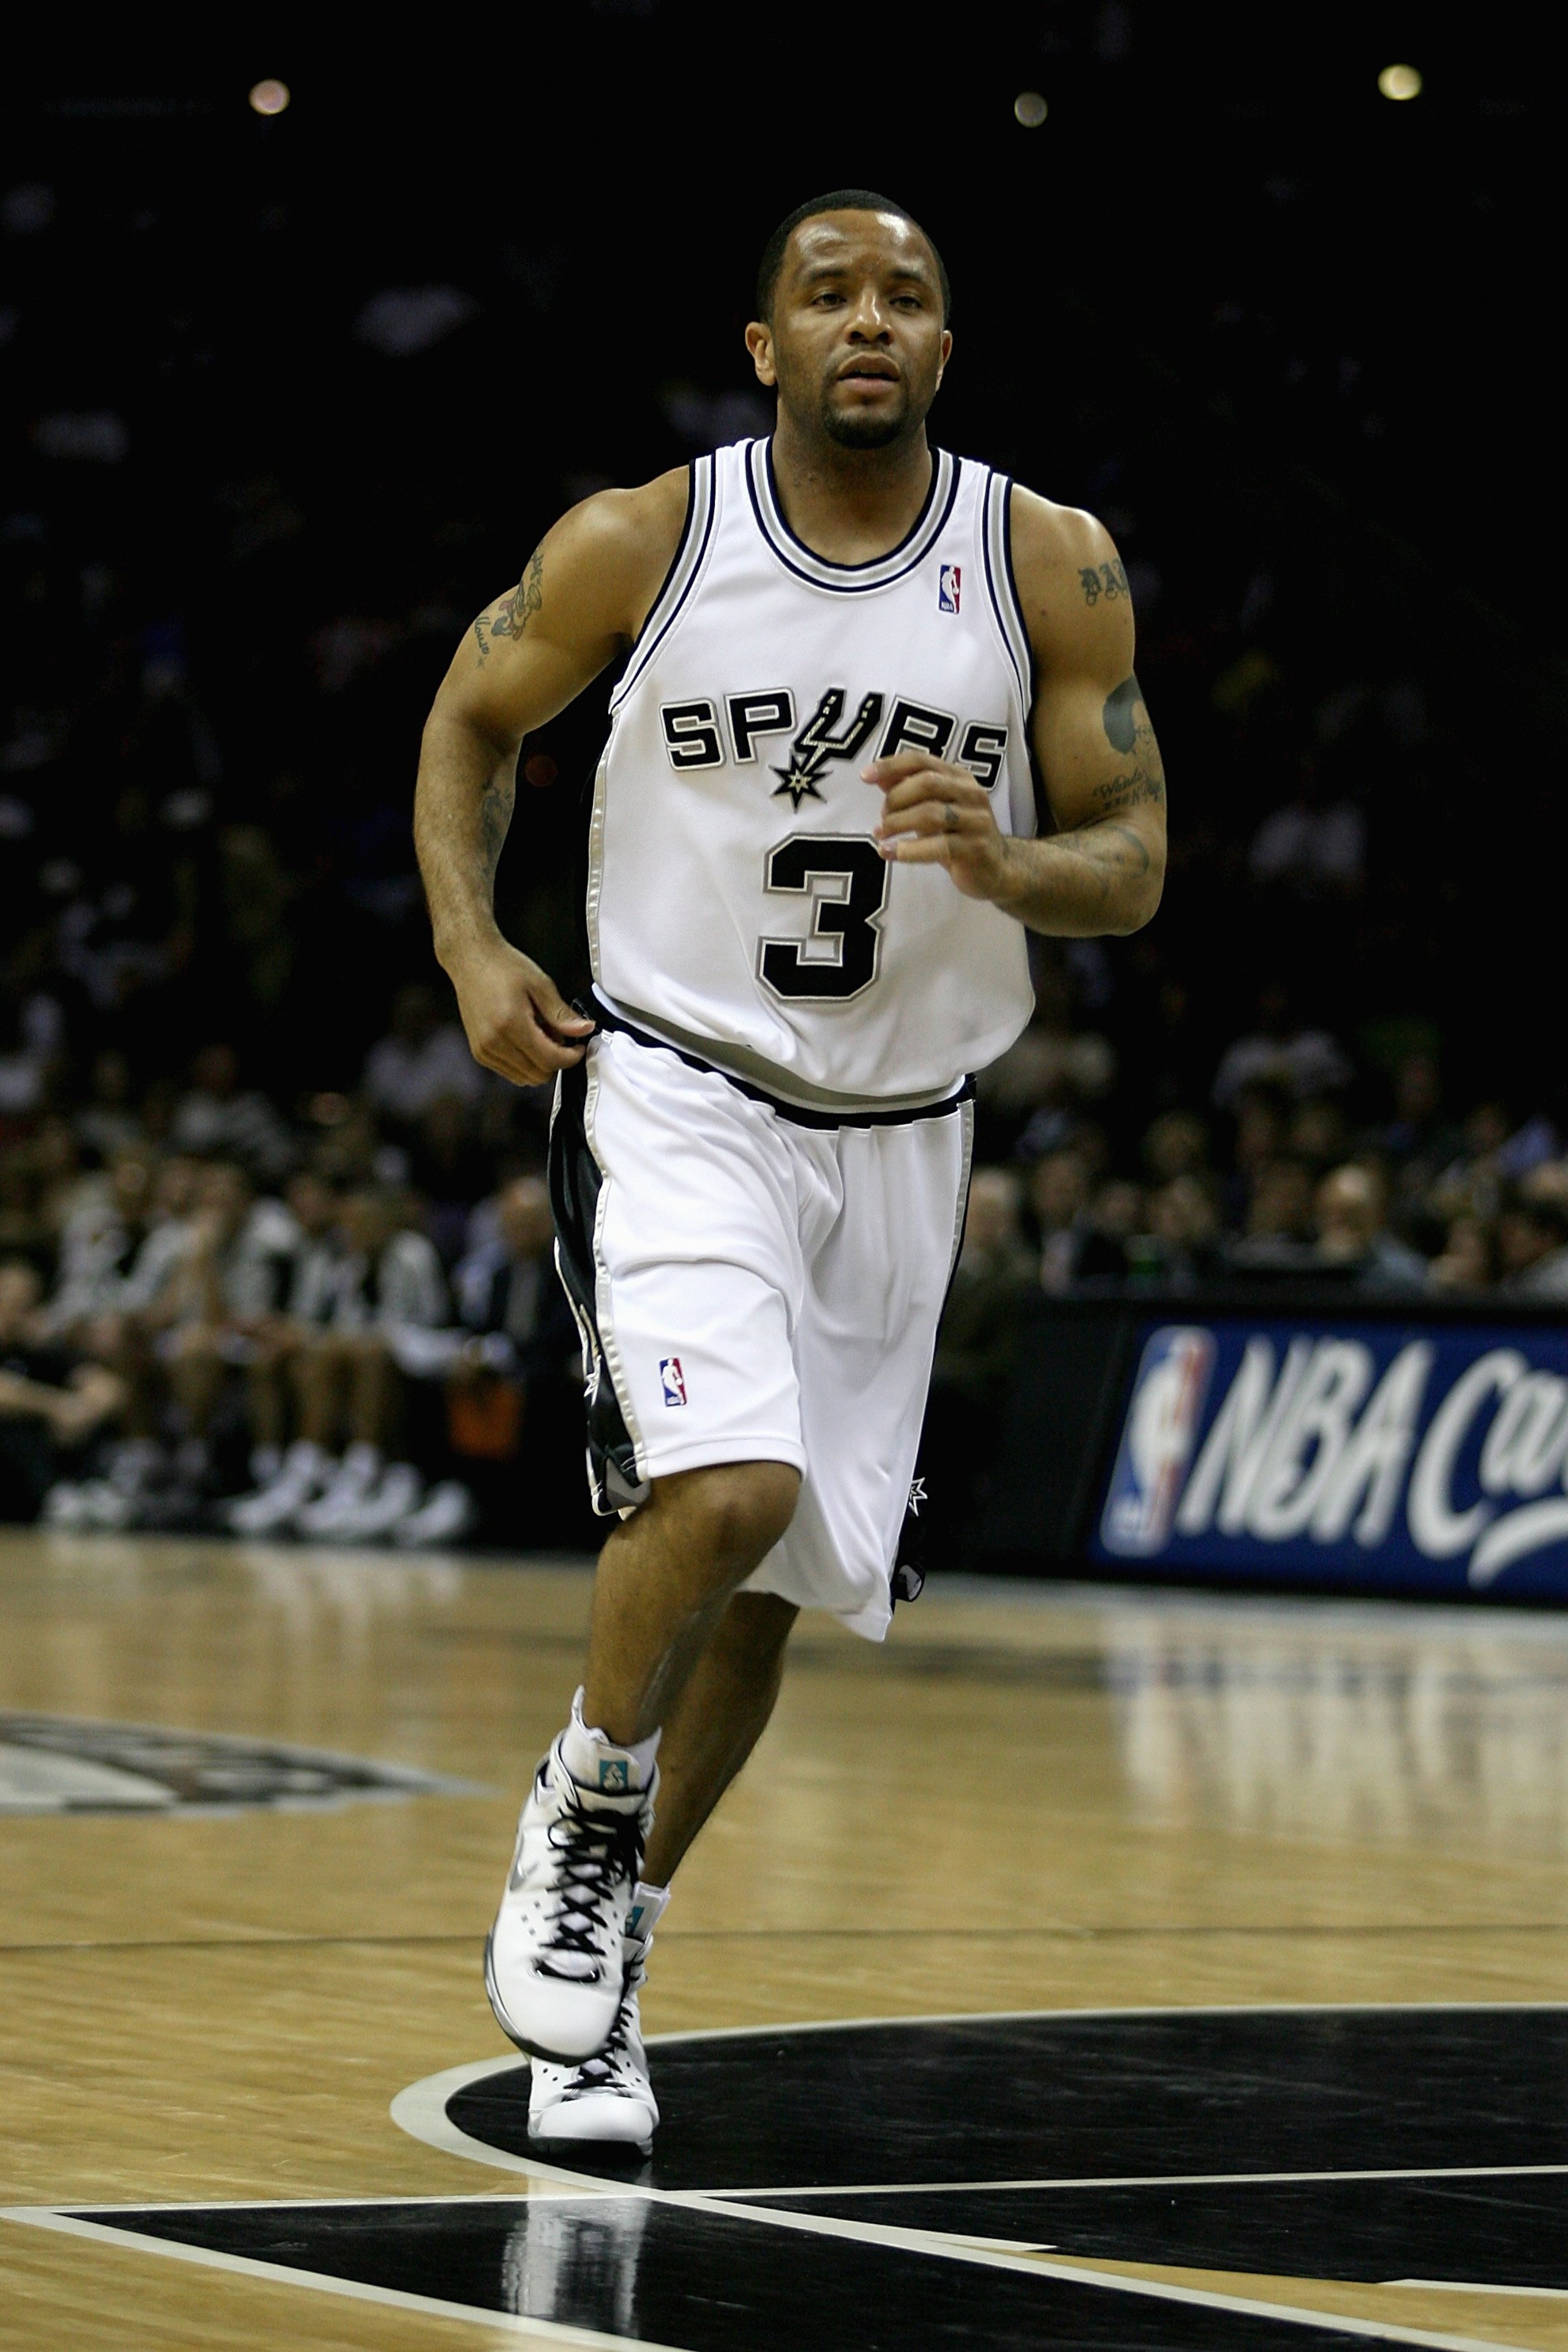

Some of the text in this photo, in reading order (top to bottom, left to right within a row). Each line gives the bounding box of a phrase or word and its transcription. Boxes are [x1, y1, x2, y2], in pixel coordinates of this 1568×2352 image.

[660, 687, 1009, 794] SPURS
[756, 831, 892, 1003] 3
[1176, 1333, 1568, 1561] NBA Ca
